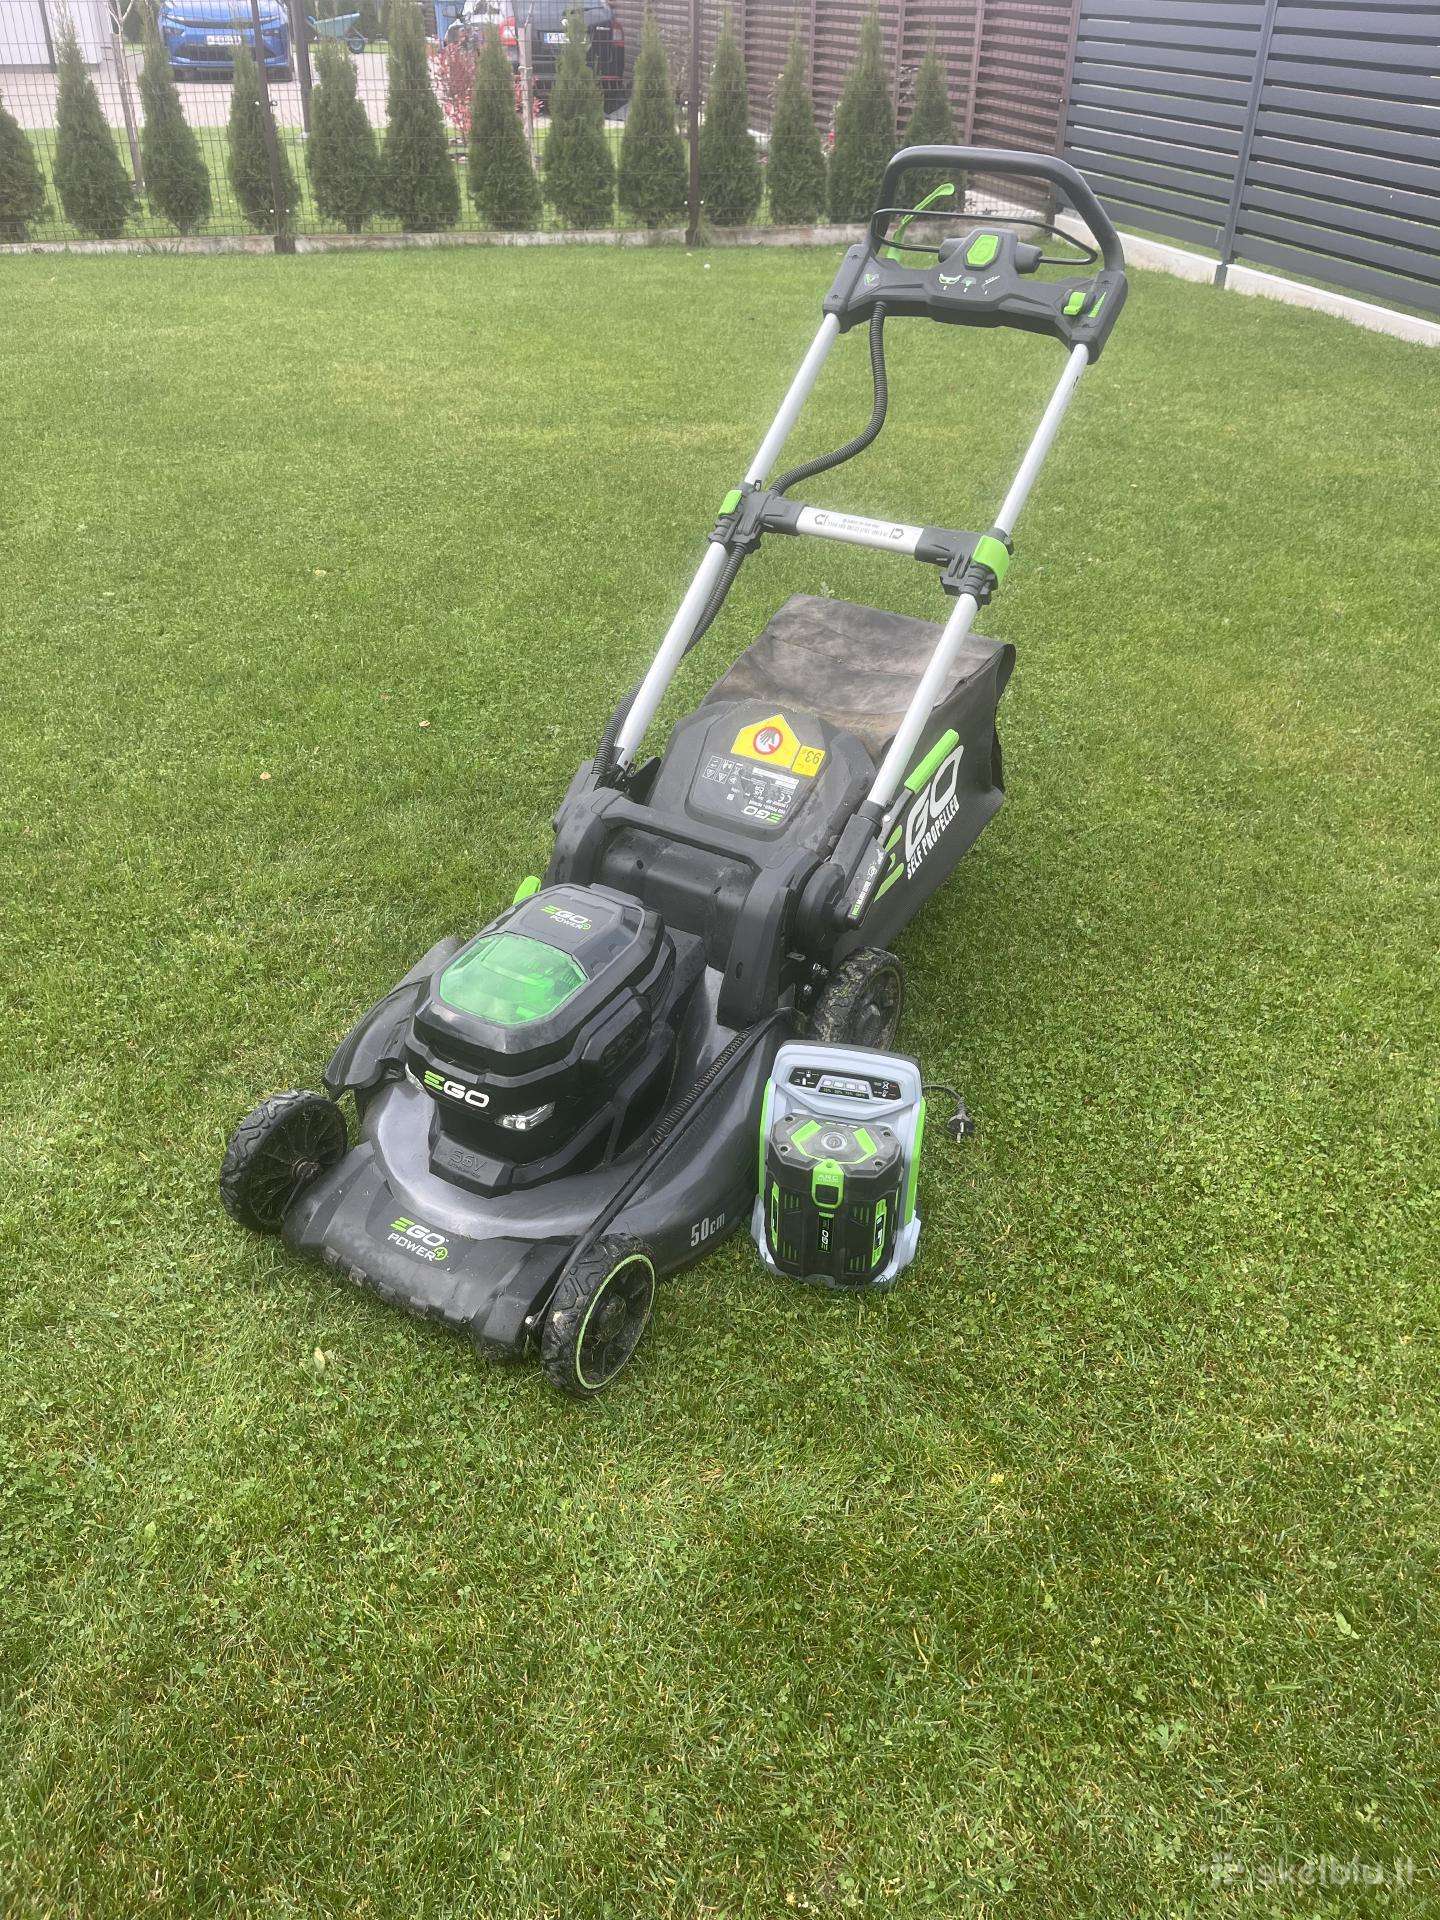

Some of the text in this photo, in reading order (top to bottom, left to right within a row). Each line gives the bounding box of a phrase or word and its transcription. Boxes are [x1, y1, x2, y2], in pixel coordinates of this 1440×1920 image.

[743, 805, 784, 824] EGO
[907, 844, 923, 880] SELF
[540, 905, 589, 925] EGO
[423, 1070, 490, 1108] EGO
[390, 1216, 446, 1247] EGO
